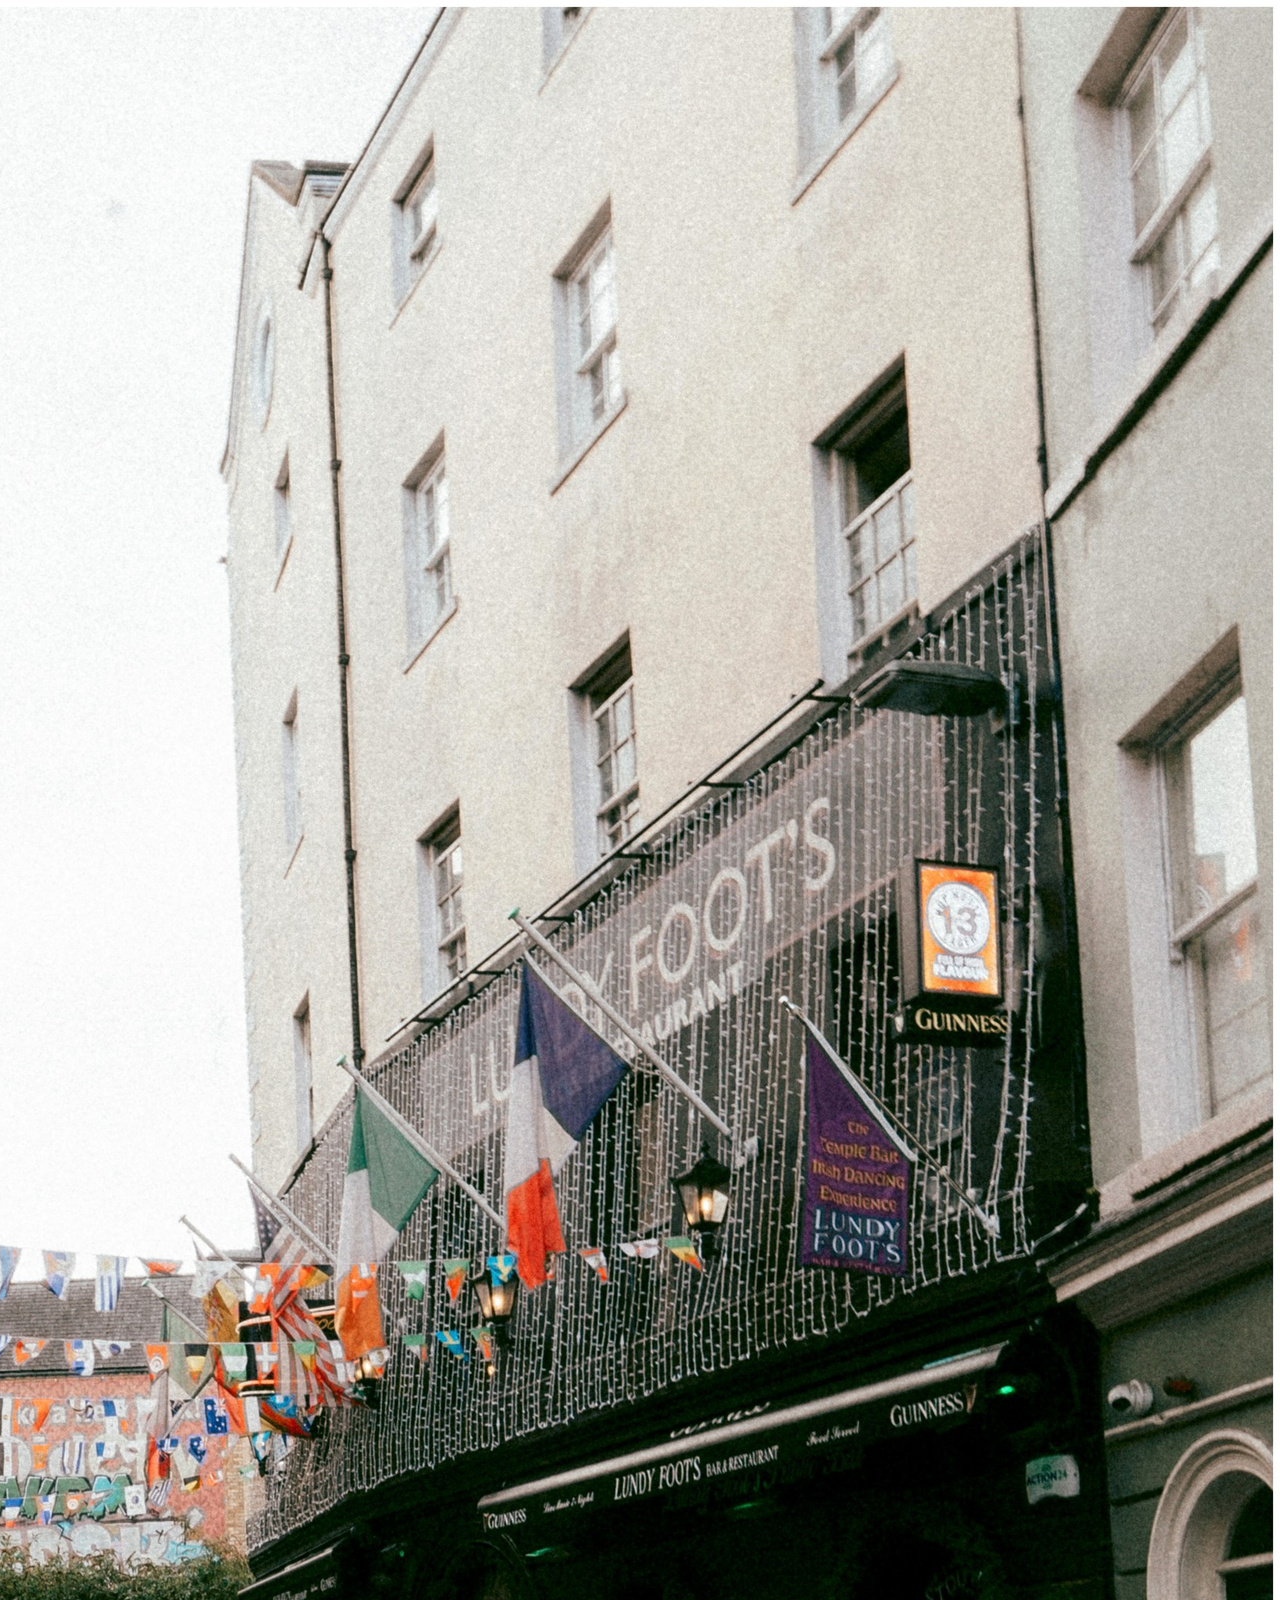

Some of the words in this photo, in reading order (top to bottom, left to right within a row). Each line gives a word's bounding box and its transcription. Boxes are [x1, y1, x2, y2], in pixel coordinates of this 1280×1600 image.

[936, 905, 977, 936] 13
[470, 949, 616, 1116] LUY
[628, 796, 836, 1012] FOOT'S
[915, 1007, 1009, 1034] GUINNESS
[814, 1208, 901, 1241] LUNDY
[813, 1232, 901, 1264] FOOT'S
[487, 1508, 527, 1530] GUINNESS
[613, 1468, 655, 1501] LUNDY
[658, 1456, 702, 1489] FOOT'S
[705, 1461, 722, 1478] BAR
[728, 1444, 780, 1471] RESTAURANT
[890, 1391, 965, 1428] GUINNESS
